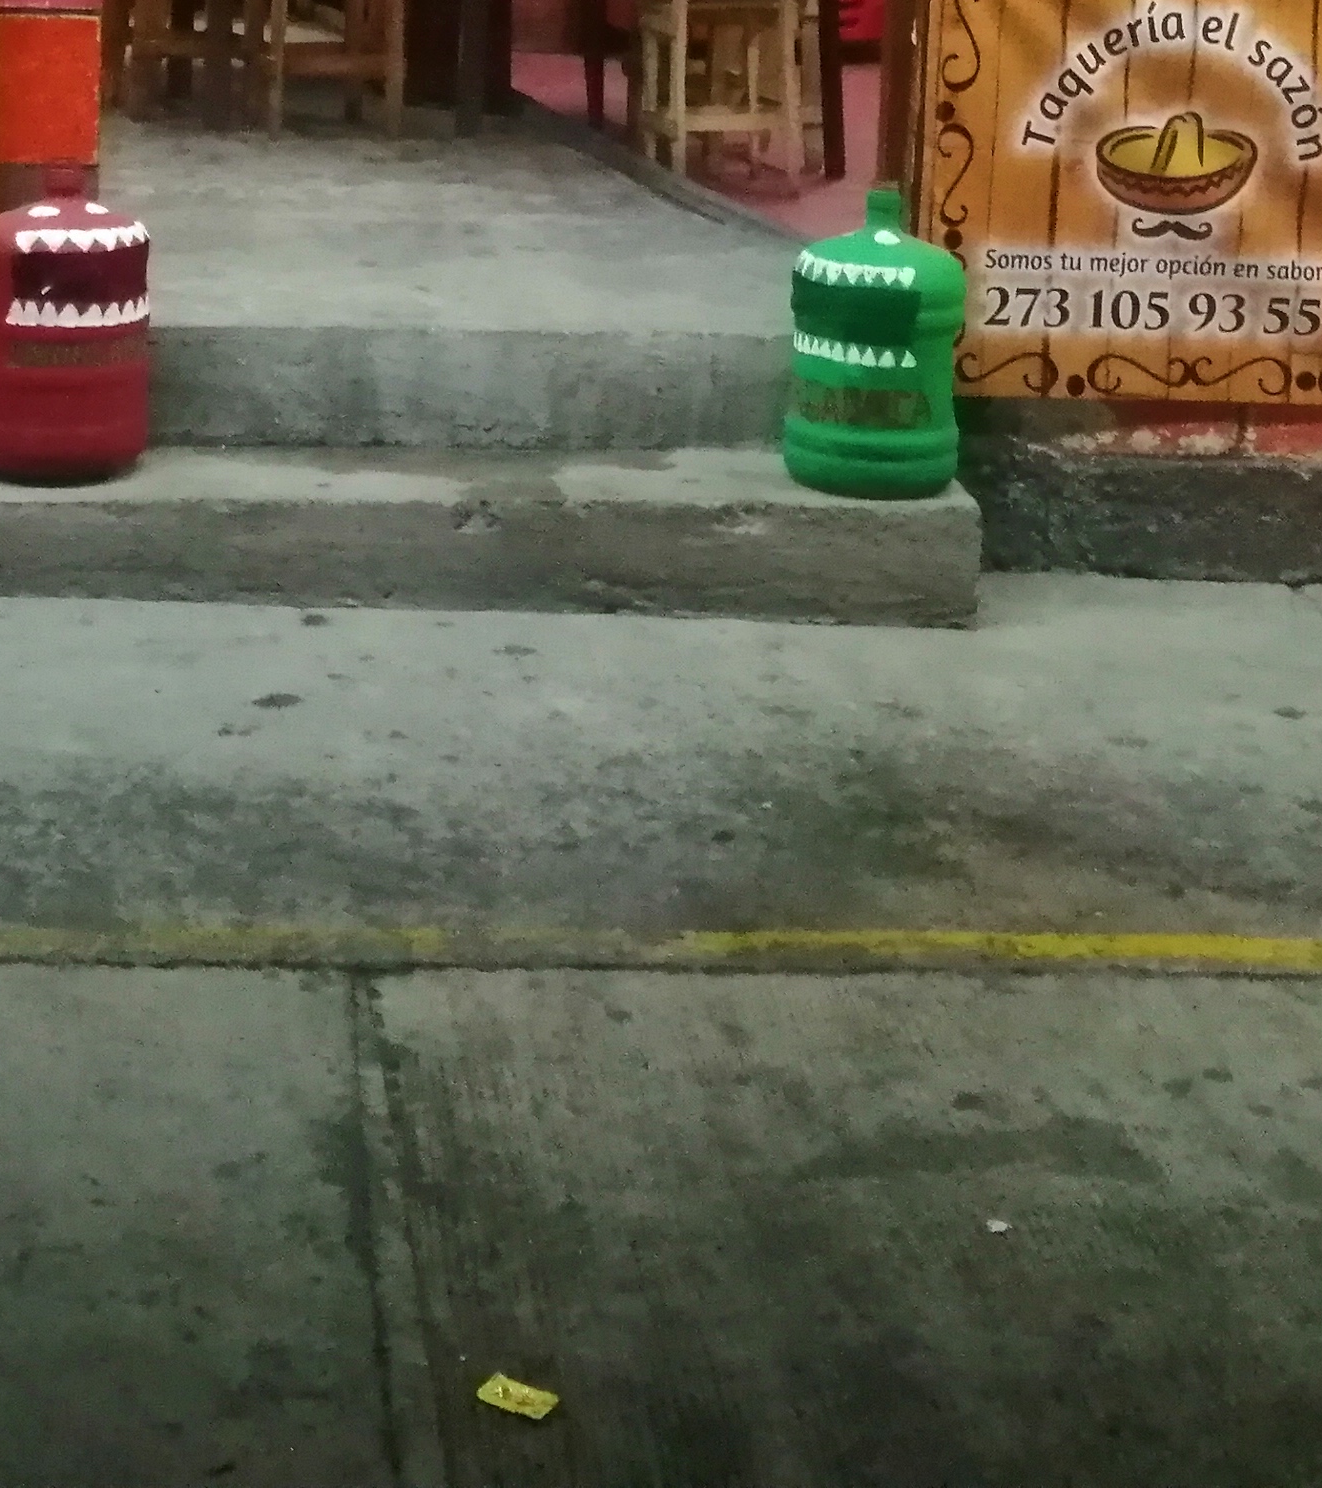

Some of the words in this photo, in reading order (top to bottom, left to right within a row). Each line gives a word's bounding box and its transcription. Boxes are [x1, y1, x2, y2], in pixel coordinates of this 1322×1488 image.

[1022, 1, 1184, 148] Taquería
[1201, 12, 1240, 51] el
[985, 249, 1053, 271] Somos
[1061, 252, 1082, 272] tu
[1089, 255, 1151, 278] mejor
[1155, 255, 1227, 281] opción
[1233, 262, 1259, 279] en
[984, 287, 1071, 328] 273
[1088, 289, 1170, 331] 105
[1188, 292, 1246, 333] 93
[1262, 296, 1322, 336] 55
